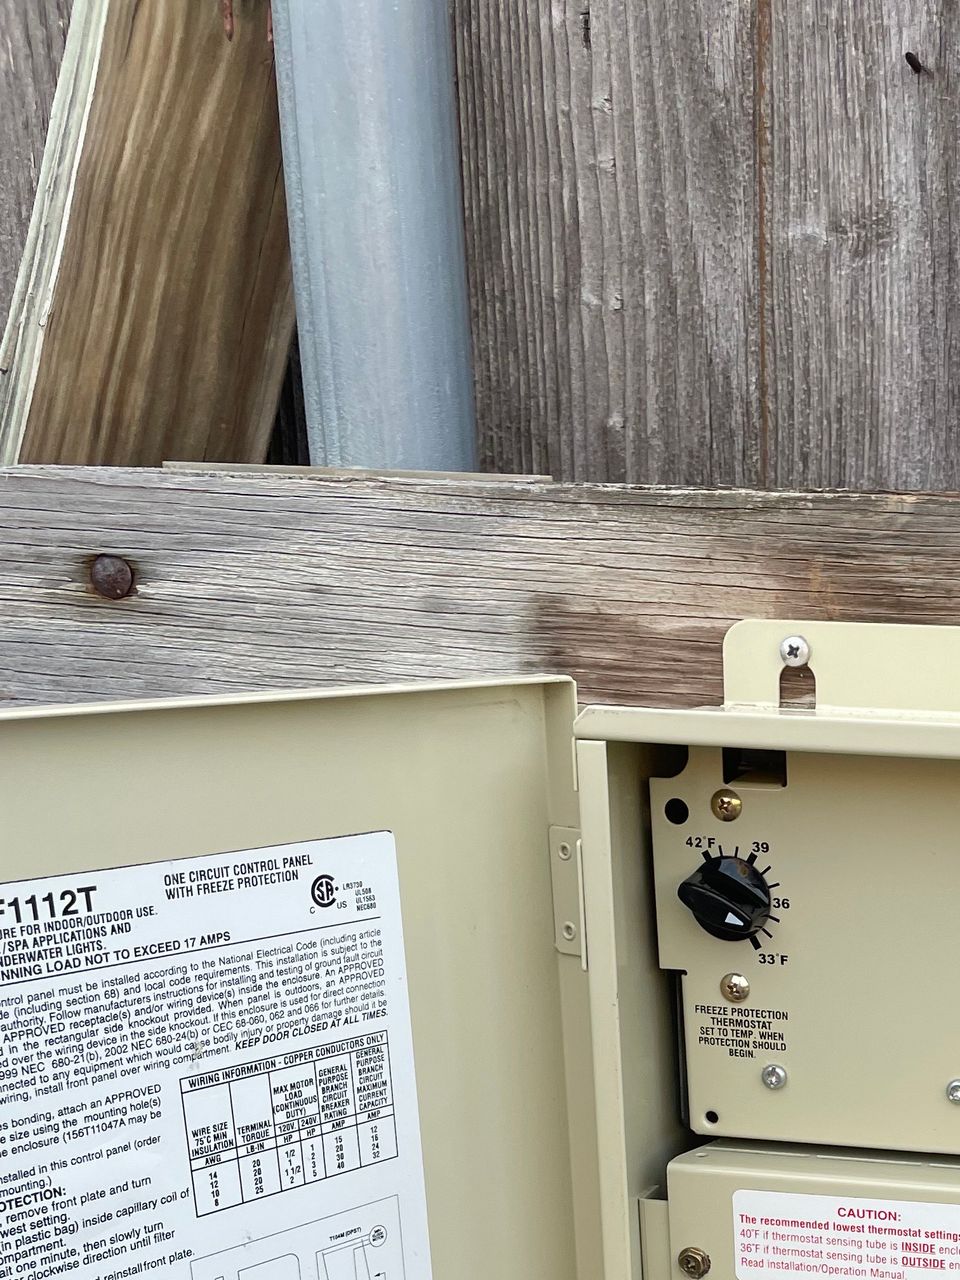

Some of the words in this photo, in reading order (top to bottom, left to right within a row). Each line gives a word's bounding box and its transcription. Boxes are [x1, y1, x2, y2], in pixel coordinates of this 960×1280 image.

[685, 835, 716, 849] 42°F
[751, 841, 769, 853] 39
[163, 872, 186, 887] ONE
[188, 865, 230, 883] CIRCUIT
[233, 858, 281, 876] CONTROL
[282, 854, 314, 869] PANEL
[165, 885, 194, 900] WITH
[196, 878, 235, 896] FREEZE
[237, 869, 299, 890] PROTECTION
[772, 897, 790, 909] 36
[19, 923, 41, 937] FOR
[43, 909, 134, 933] INDOOR/OUTDOOR
[135, 905, 158, 918] USE.
[32, 925, 108, 948] APPLICATIONS
[110, 921, 132, 936] AND
[45, 957, 82, 973] LOAD
[84, 951, 111, 967] NOT
[112, 948, 131, 961] TO
[133, 940, 181, 958] EXCEED
[184, 937, 197, 949] 17
[199, 931, 231, 946] AMPS
[65, 939, 107, 957] LIGHTS.
[758, 953, 788, 966] 33°F
[694, 1004, 729, 1016] FREEZE
[730, 1007, 789, 1021] PROTECTION
[233, 1035, 261, 1051] KEEP
[262, 1030, 290, 1045] DOOR
[292, 1021, 329, 1038] CLOSED
[330, 1017, 342, 1029] AT
[342, 1014, 360, 1026] ALL
[361, 1007, 388, 1021] TIMES.
[710, 1016, 773, 1031] THERMOSTAT
[699, 1026, 715, 1036] SET
[716, 1027, 729, 1037] TO
[730, 1028, 757, 1040] TEMP.
[758, 1030, 784, 1042] WHEN
[698, 1036, 750, 1049] PROTECTION
[752, 1040, 787, 1052] SHOULD
[188, 1072, 220, 1089] WIRING
[221, 1059, 277, 1081] INFORMATION
[283, 1050, 314, 1066] COPPER
[315, 1037, 365, 1058] CONDUCTORS
[366, 1033, 384, 1046] ONLY
[729, 1048, 756, 1059] BEGIN.
[10, 1111, 55, 1128] bonding,
[57, 1102, 88, 1117] attach
[90, 1099, 103, 1109] an
[104, 1083, 162, 1106] APPROVED
[191, 1125, 211, 1138] WIRE
[212, 1121, 229, 1133] SIZE
[236, 1119, 273, 1135] TERMINAL
[194, 1135, 212, 1147] 75°C
[212, 1130, 228, 1142] MIN
[241, 1128, 270, 1144] TORQUE
[191, 1138, 234, 1158] INSULATION
[245, 1141, 268, 1156] LB-IN
[204, 1154, 222, 1166] AWG
[837, 1207, 902, 1222] CAUTION:
[739, 1213, 757, 1225] The
[760, 1217, 830, 1231] recommended
[832, 1221, 865, 1234] lowest
[867, 1224, 922, 1238] thermostat
[739, 1228, 760, 1239] 40°F
[762, 1230, 769, 1240] if
[771, 1231, 823, 1244] thermostat
[825, 1237, 863, 1250] sensing
[865, 1239, 887, 1250] tube
[890, 1242, 898, 1251] is
[901, 1241, 936, 1256] INSIDE
[740, 1242, 761, 1254] 36°F
[763, 1244, 770, 1254] if
[772, 1245, 824, 1260] thermostat
[826, 1251, 863, 1265] sensing
[866, 1253, 887, 1265] tube
[890, 1257, 899, 1266] is
[901, 1255, 946, 1271] OUTSIDE
[740, 1257, 765, 1269] Read
[766, 1259, 867, 1277] Installation/Operation
[870, 1267, 908, 1280] Manual.
